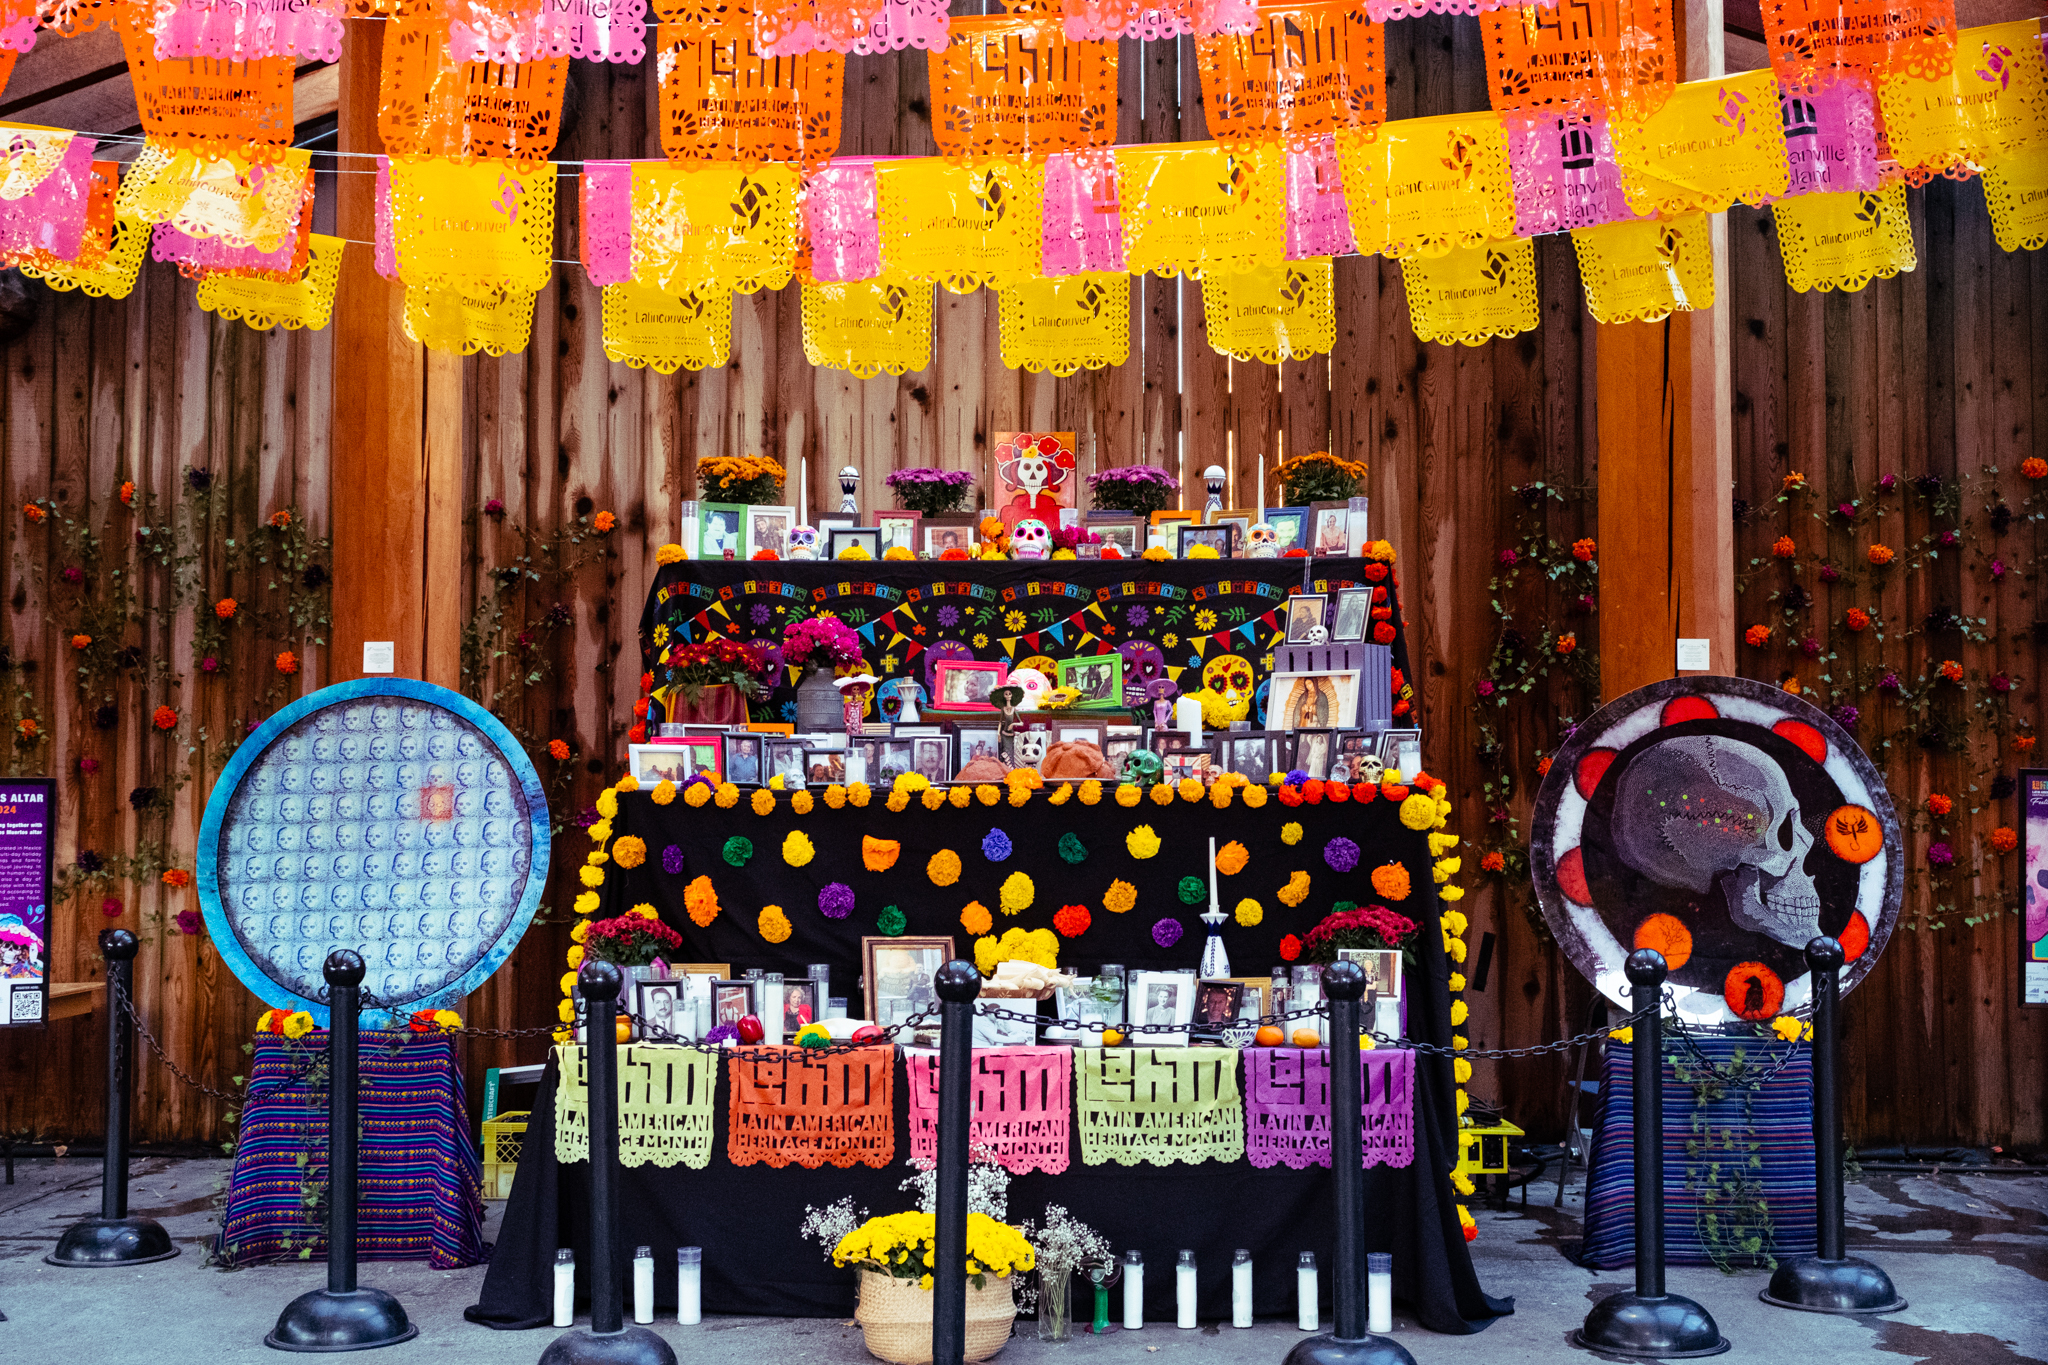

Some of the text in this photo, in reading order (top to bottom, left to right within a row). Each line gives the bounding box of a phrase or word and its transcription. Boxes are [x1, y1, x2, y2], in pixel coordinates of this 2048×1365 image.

[10, 793, 44, 803] ALTAR
[487, 1081, 496, 1120] STERCRAFT
[736, 1112, 888, 1132] LATIN AMERICAN
[1084, 1107, 1236, 1128] LATIN AMERICAN
[1254, 1112, 1305, 1131] LATIN
[968, 1119, 1064, 1138] AMERICAN
[1084, 1128, 1236, 1147] HERITAGE MONTH
[647, 1134, 708, 1149] MONTH
[736, 1133, 886, 1150] HERITAGE MONTH
[1000, 1142, 1064, 1155] MONTH
